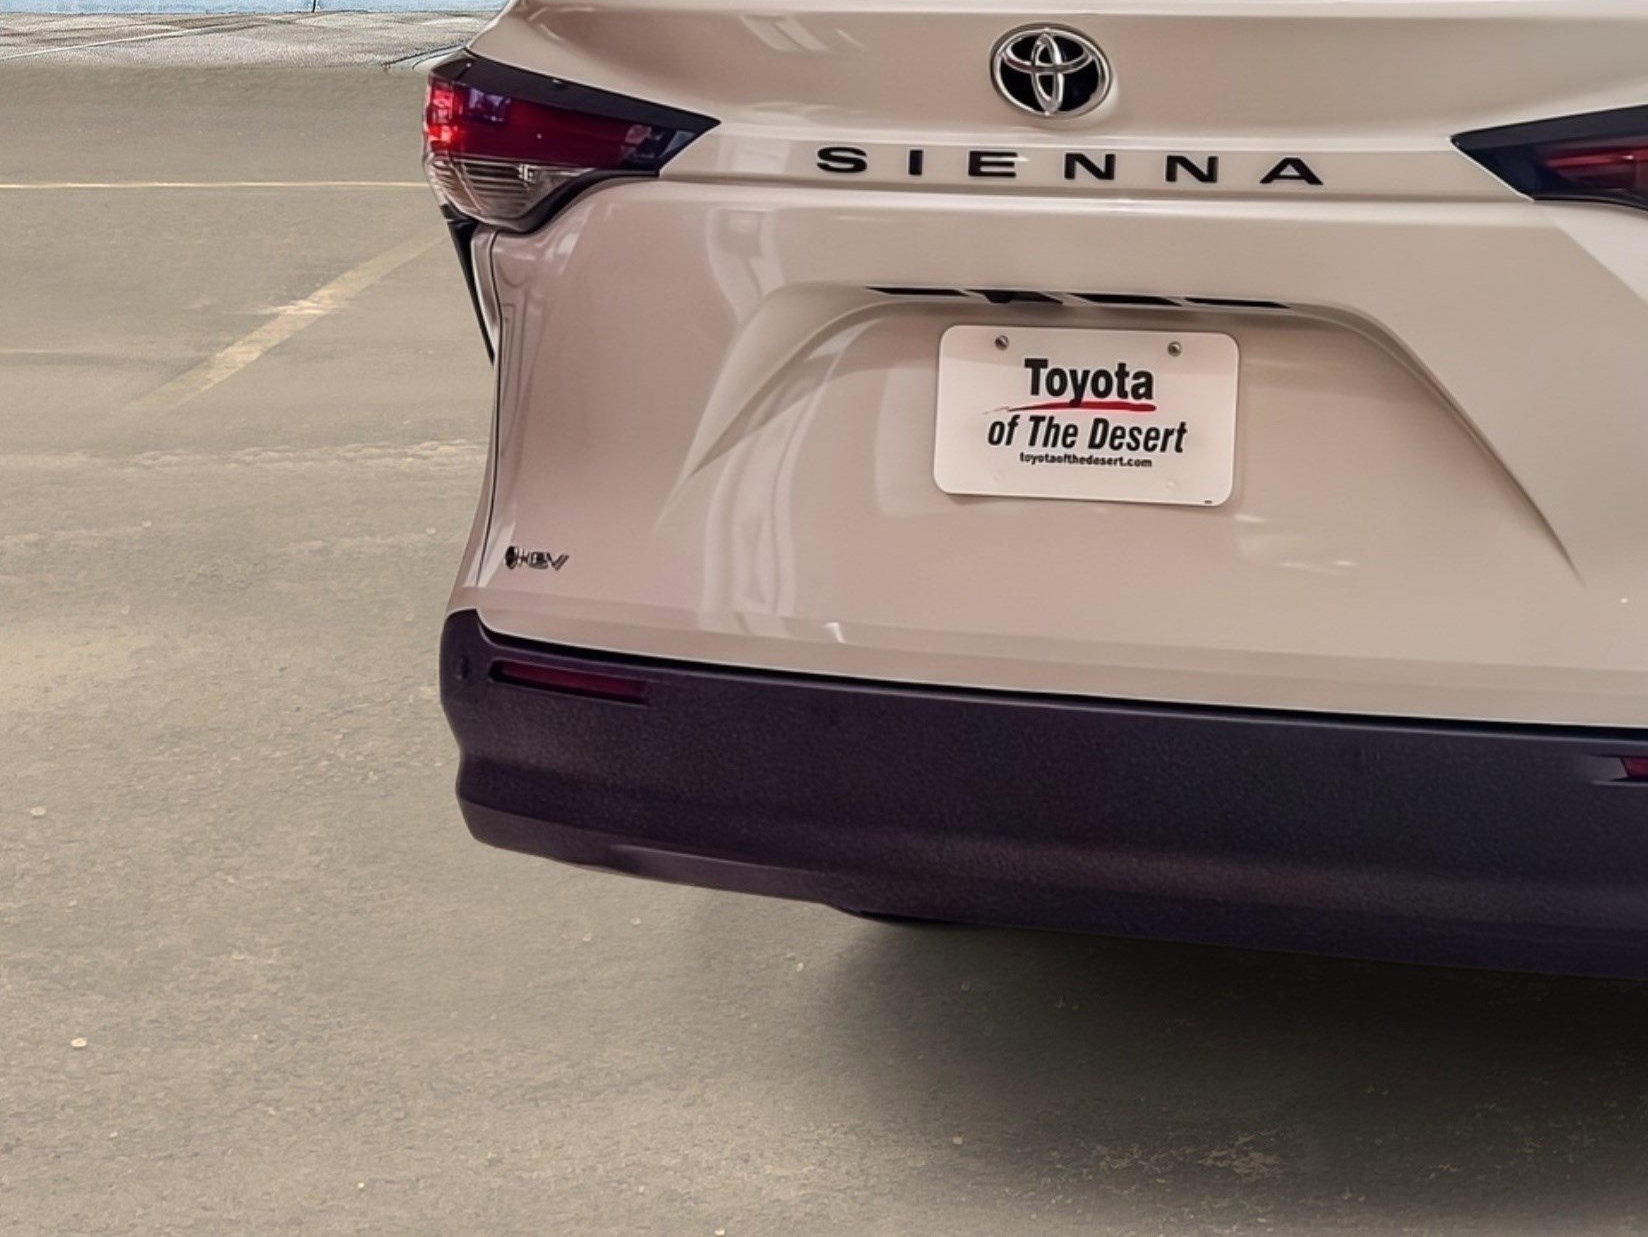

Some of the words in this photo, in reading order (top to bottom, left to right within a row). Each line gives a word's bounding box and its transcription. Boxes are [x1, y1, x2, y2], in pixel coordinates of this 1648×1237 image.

[816, 146, 1324, 186] SIENNA
[1024, 358, 1154, 407] Toyota
[987, 415, 1020, 446] of
[1028, 416, 1078, 449] The
[1088, 418, 1187, 453] Desert
[1019, 451, 1153, 468] toyotaofthedesert.com
